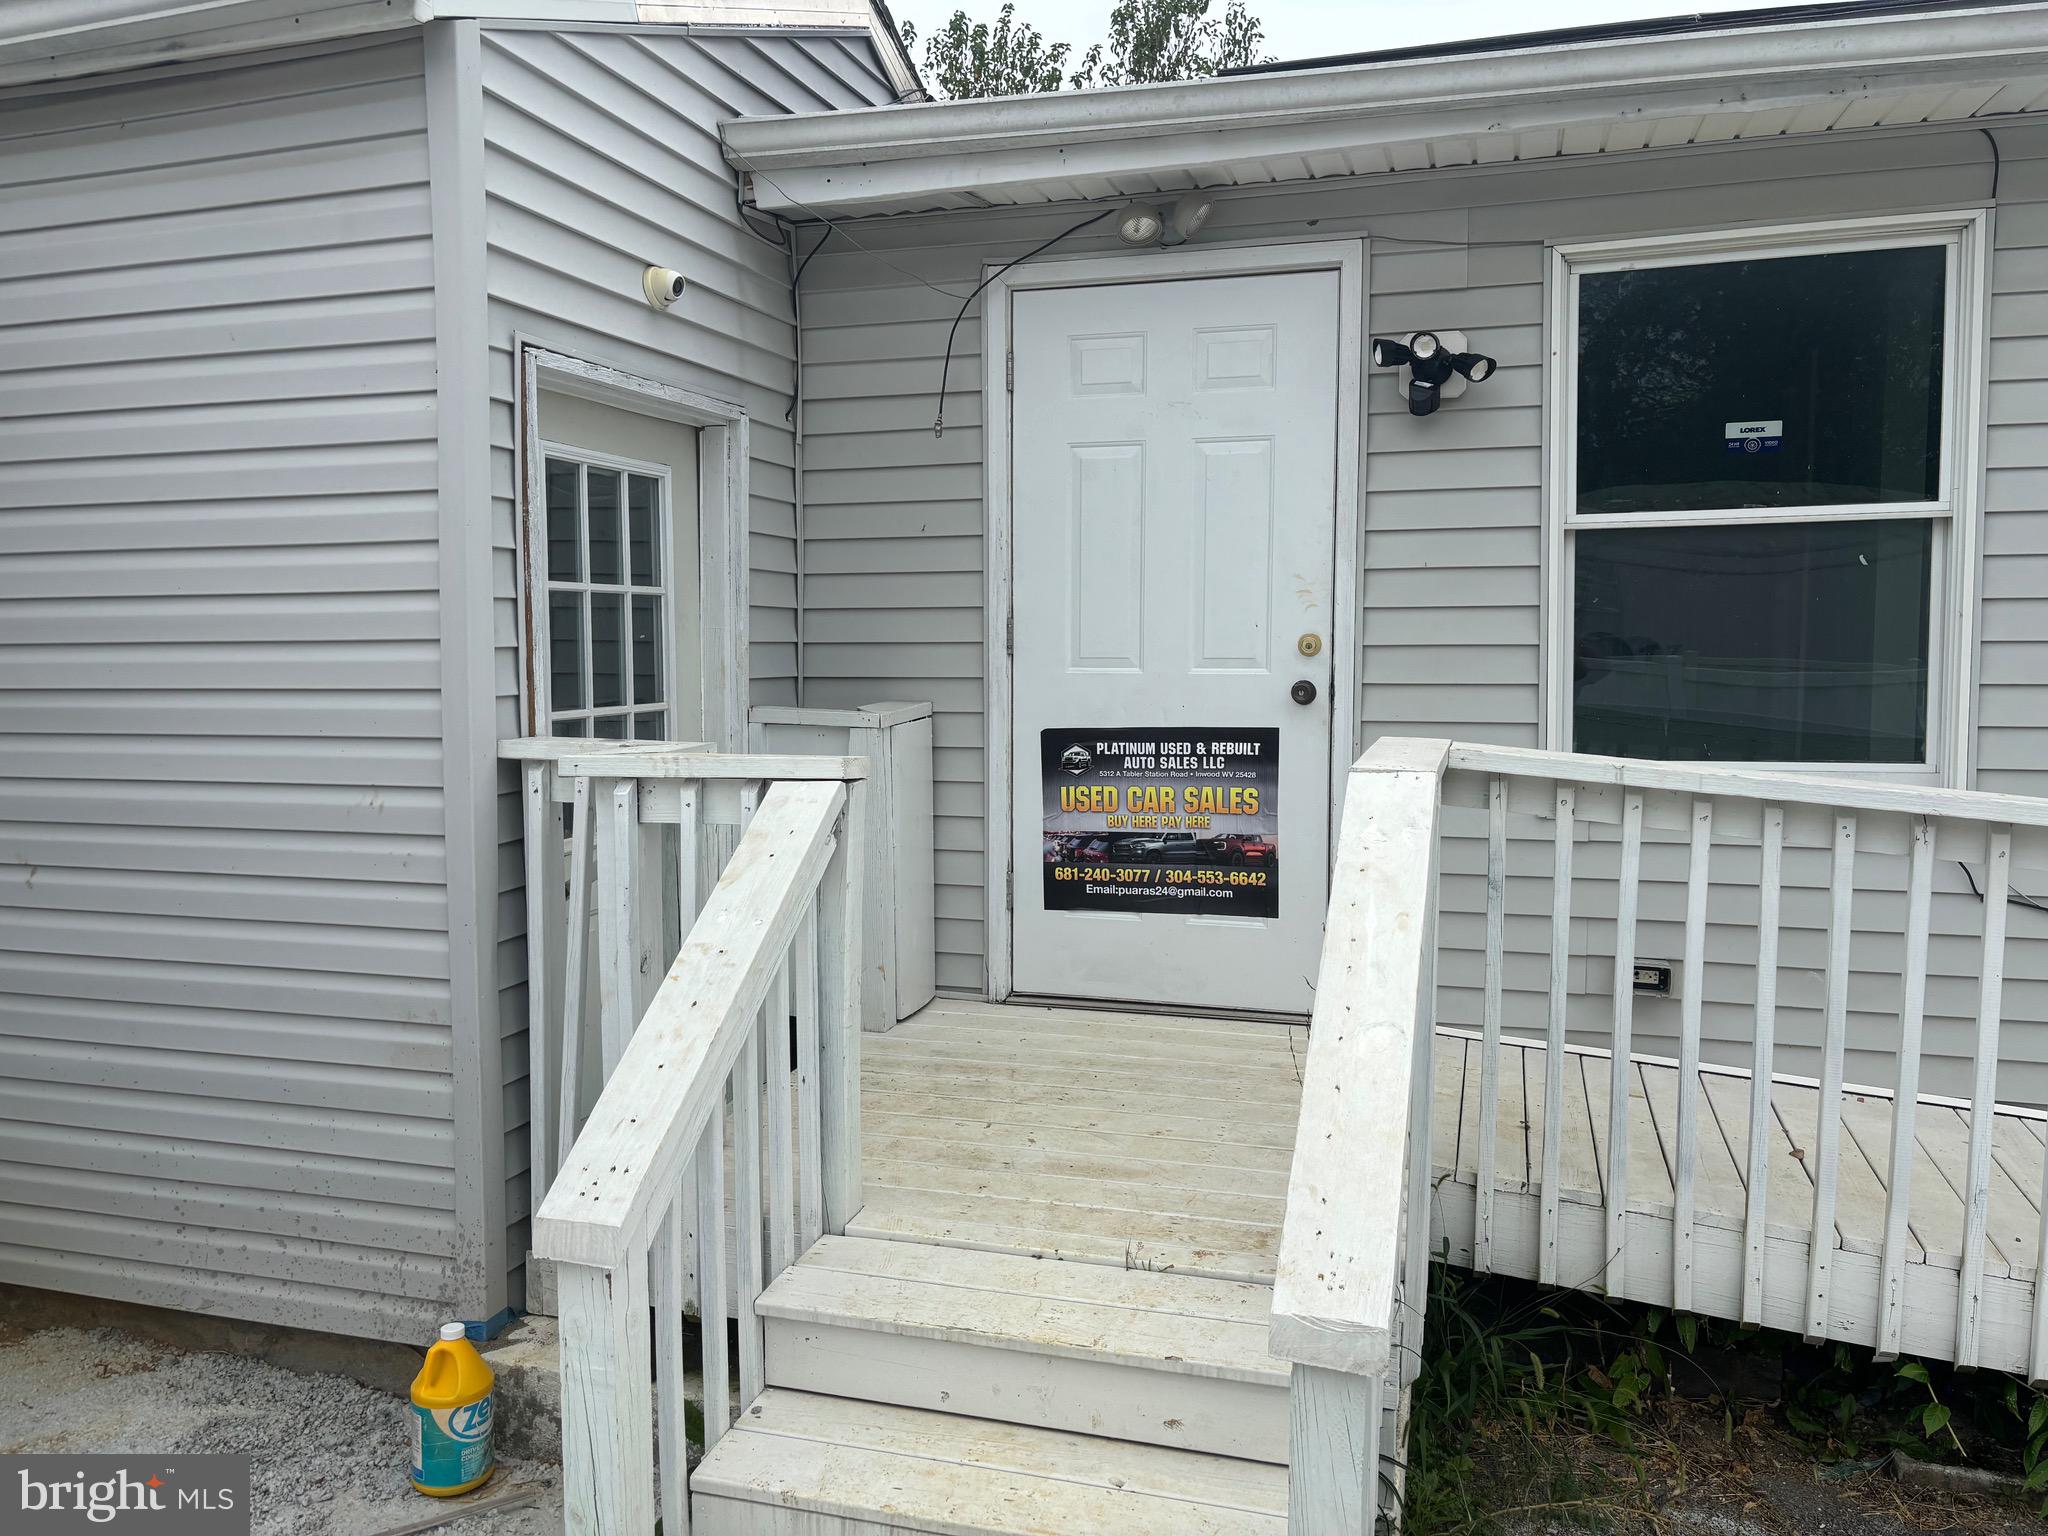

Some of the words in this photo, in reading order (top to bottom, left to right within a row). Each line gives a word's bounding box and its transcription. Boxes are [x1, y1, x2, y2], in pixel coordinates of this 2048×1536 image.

[1096, 742, 1156, 755] PLATINUM
[1160, 742, 1191, 755] USED
[1196, 742, 1207, 755] &
[1211, 742, 1261, 756] REBUILT
[1123, 756, 1155, 769] AUTO
[1160, 756, 1198, 769] SALES
[1203, 756, 1225, 769] LLC
[1144, 770, 1169, 778] Station
[1235, 771, 1257, 779] 25428
[1060, 785, 1119, 813] USED
[1127, 785, 1176, 814] CAR
[1183, 786, 1260, 816] SALES
[1107, 815, 1129, 829] BUY
[1131, 815, 1158, 829] HERE
[1161, 815, 1182, 829] PAY
[1185, 815, 1211, 830] HERE
[1054, 866, 1151, 883] 681-240-3077
[1165, 869, 1267, 887] 304-553-6642
[1086, 884, 1233, 898] Email:puaras24@gmail.com
